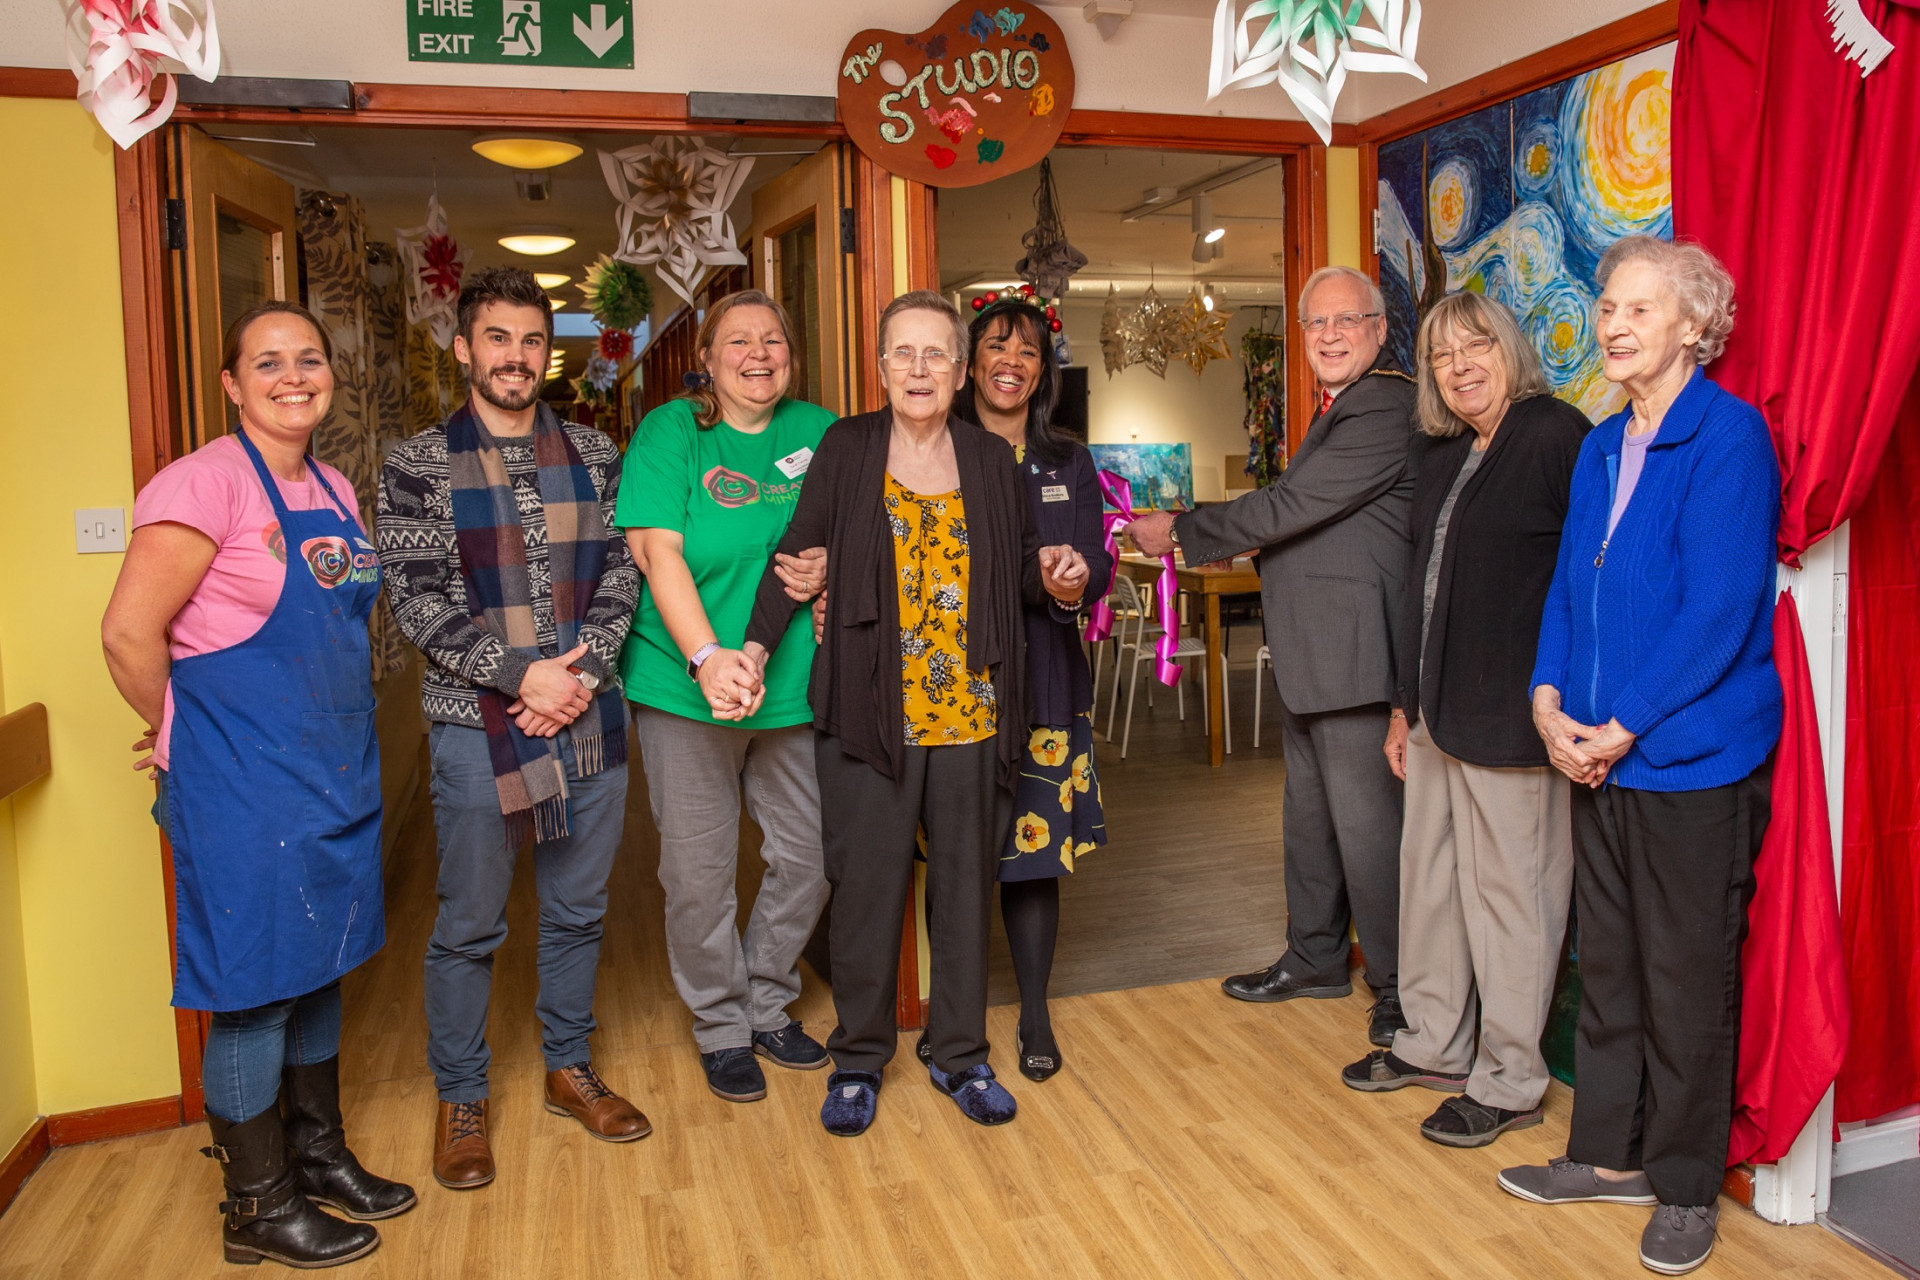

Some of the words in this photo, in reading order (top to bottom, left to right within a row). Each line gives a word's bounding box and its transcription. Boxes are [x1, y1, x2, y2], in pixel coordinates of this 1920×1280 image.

[417, 0, 474, 17] FIRE
[419, 33, 475, 54] EXIT
[842, 41, 883, 84] The
[879, 48, 1040, 144] STUDIO
